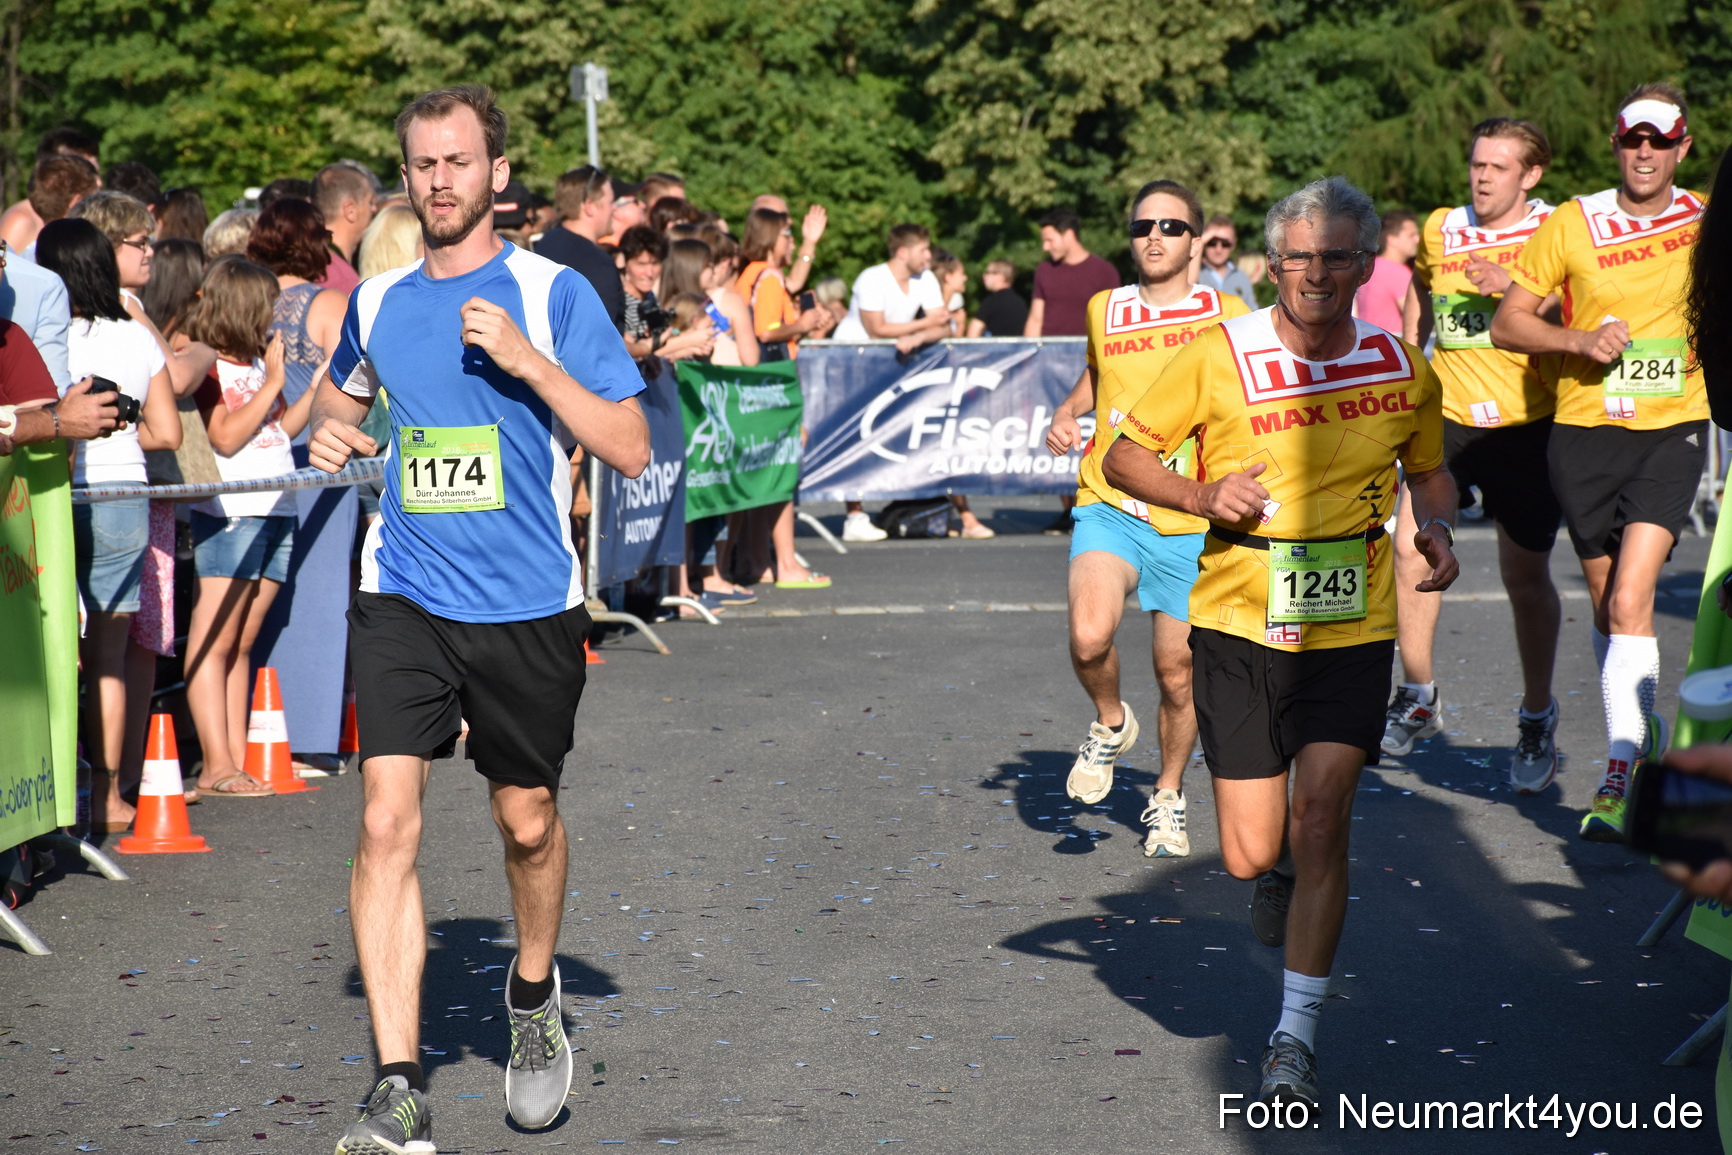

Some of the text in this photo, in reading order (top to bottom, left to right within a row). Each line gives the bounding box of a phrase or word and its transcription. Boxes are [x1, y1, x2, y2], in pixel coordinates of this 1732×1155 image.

[1597, 229, 1700, 270] MAX BÖ
[1438, 313, 1486, 333] 1343
[1104, 335, 1155, 357] MAX
[1616, 358, 1676, 380] 1284
[1250, 390, 1416, 436] MAX BÖGL
[408, 456, 487, 488] 1174
[928, 455, 1080, 475] AUTOMOBI
[415, 489, 476, 498] Dürr Johannes
[1284, 568, 1357, 599] 1243
[1289, 598, 1352, 608] Reichert Michael
[1298, 607, 1311, 615] Bögl
[1311, 606, 1340, 614] Bauservice
